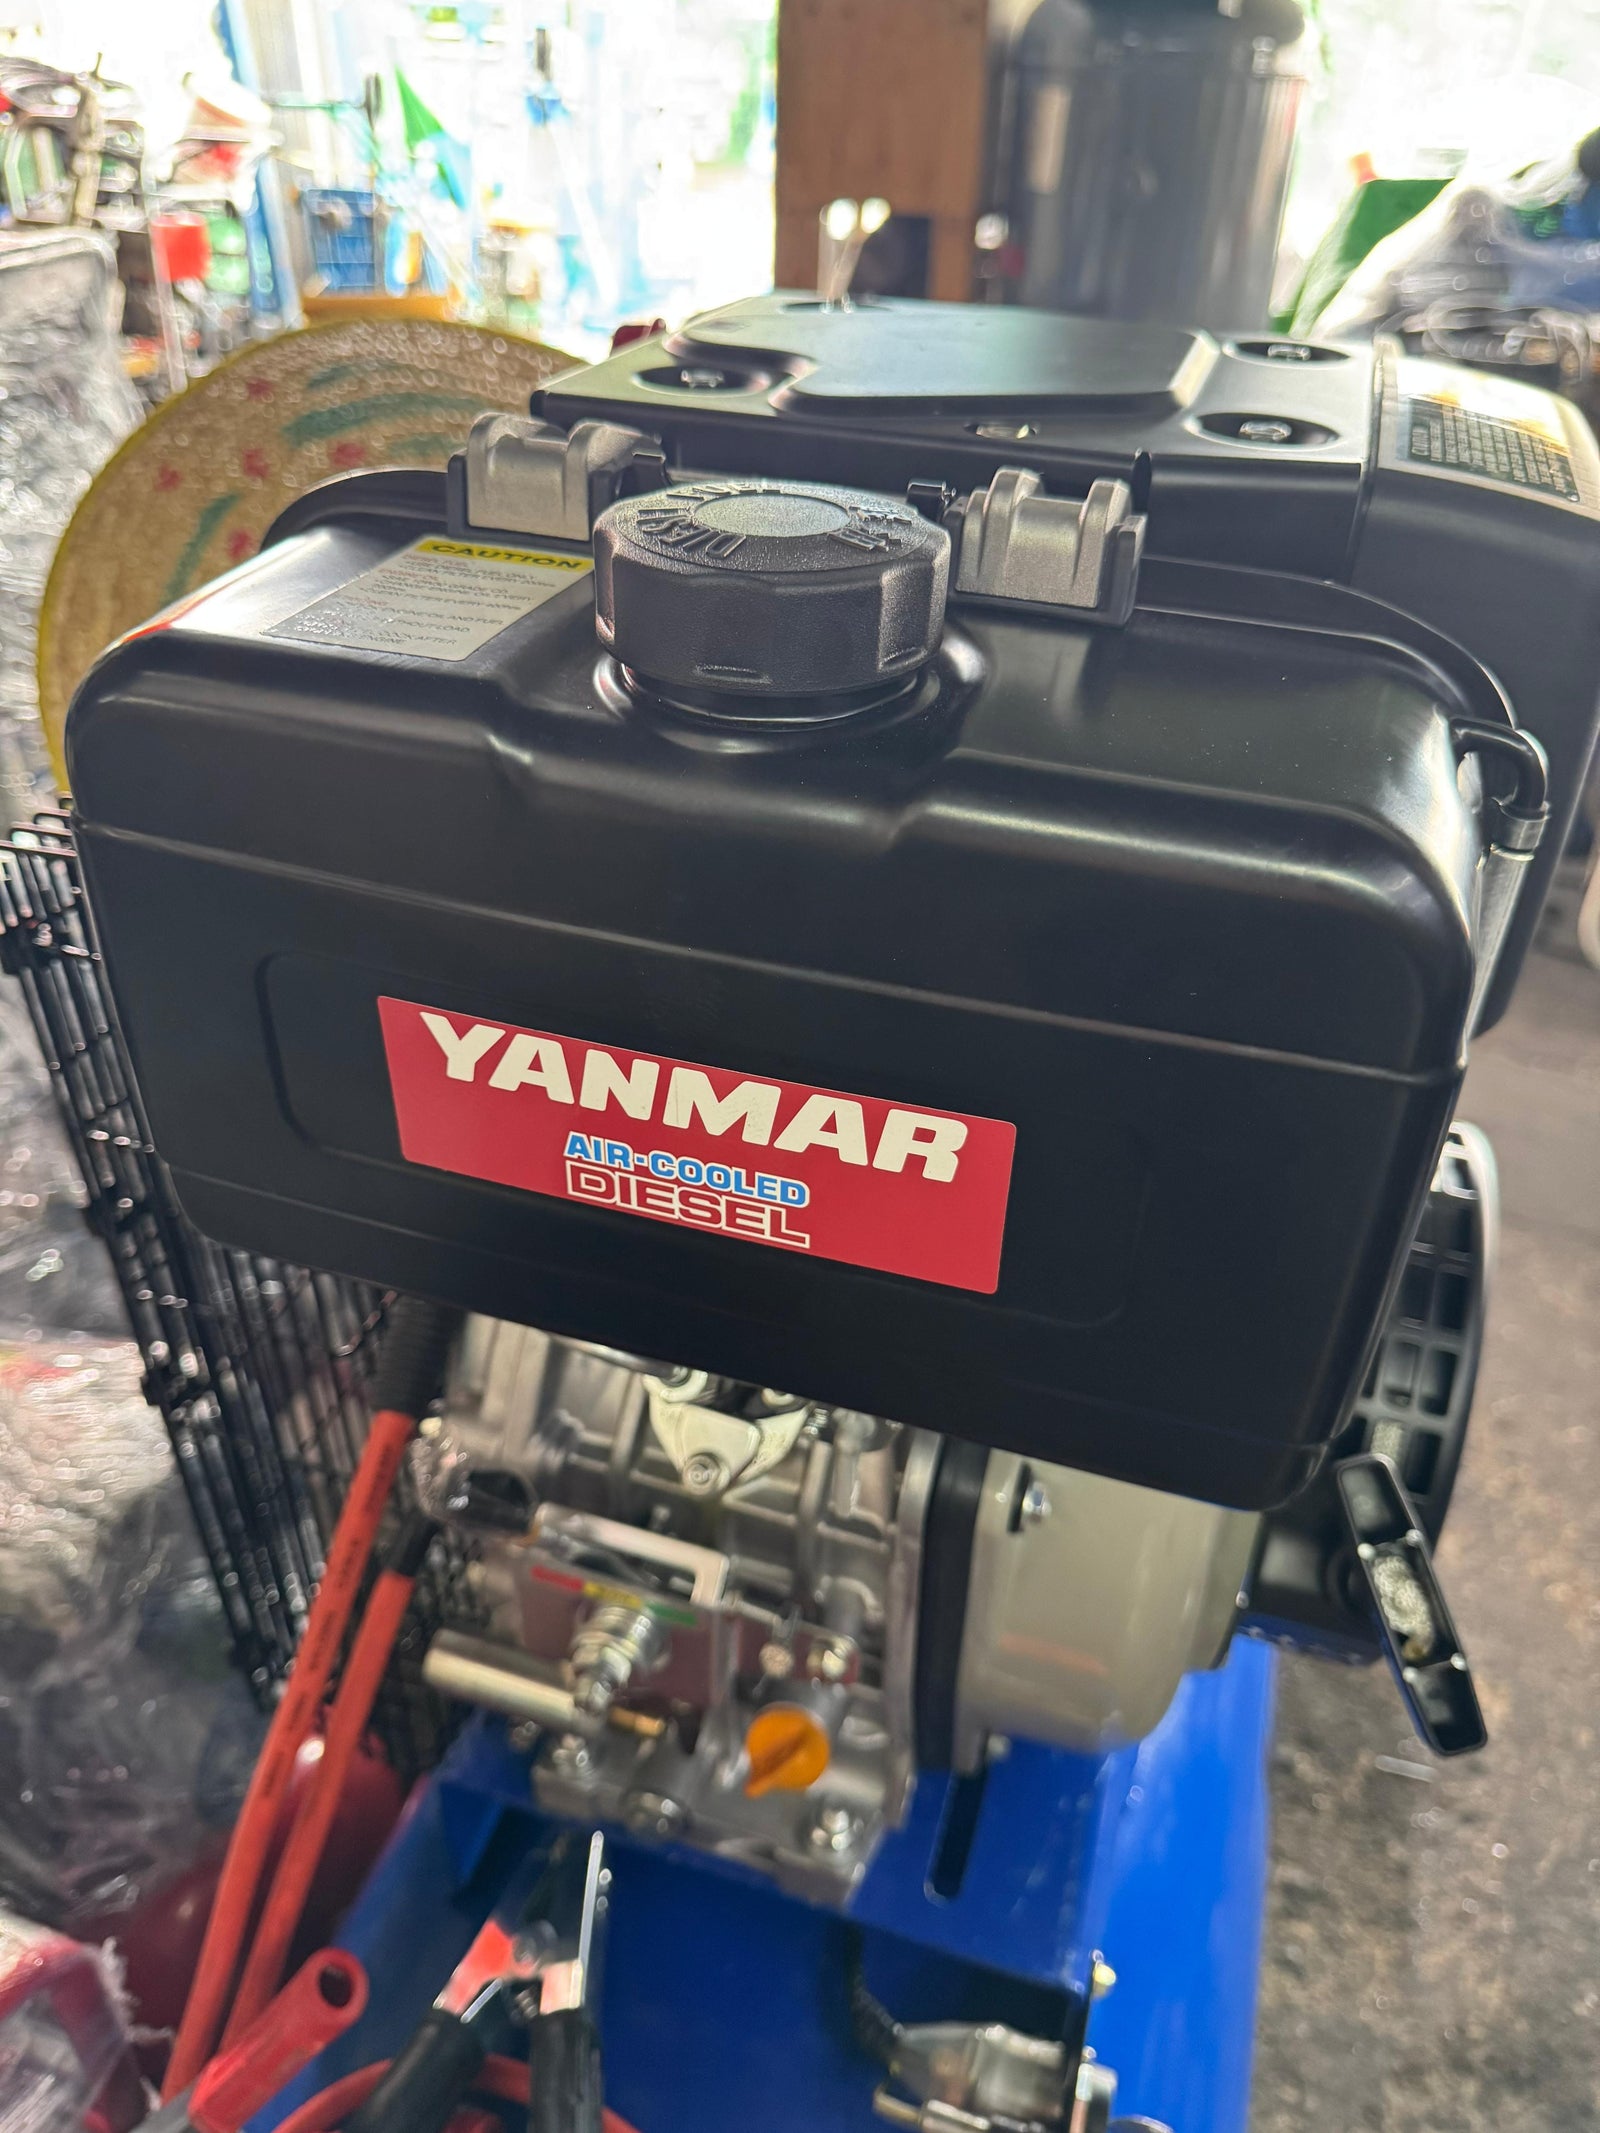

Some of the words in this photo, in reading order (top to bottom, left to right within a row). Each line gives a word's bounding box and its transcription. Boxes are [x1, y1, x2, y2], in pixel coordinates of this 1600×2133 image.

[432, 545, 581, 569] CAUTION
[419, 1010, 969, 1184] YANMAR
[563, 1130, 811, 1210] AIR-COOLED
[564, 1160, 811, 1250] DIESEL
